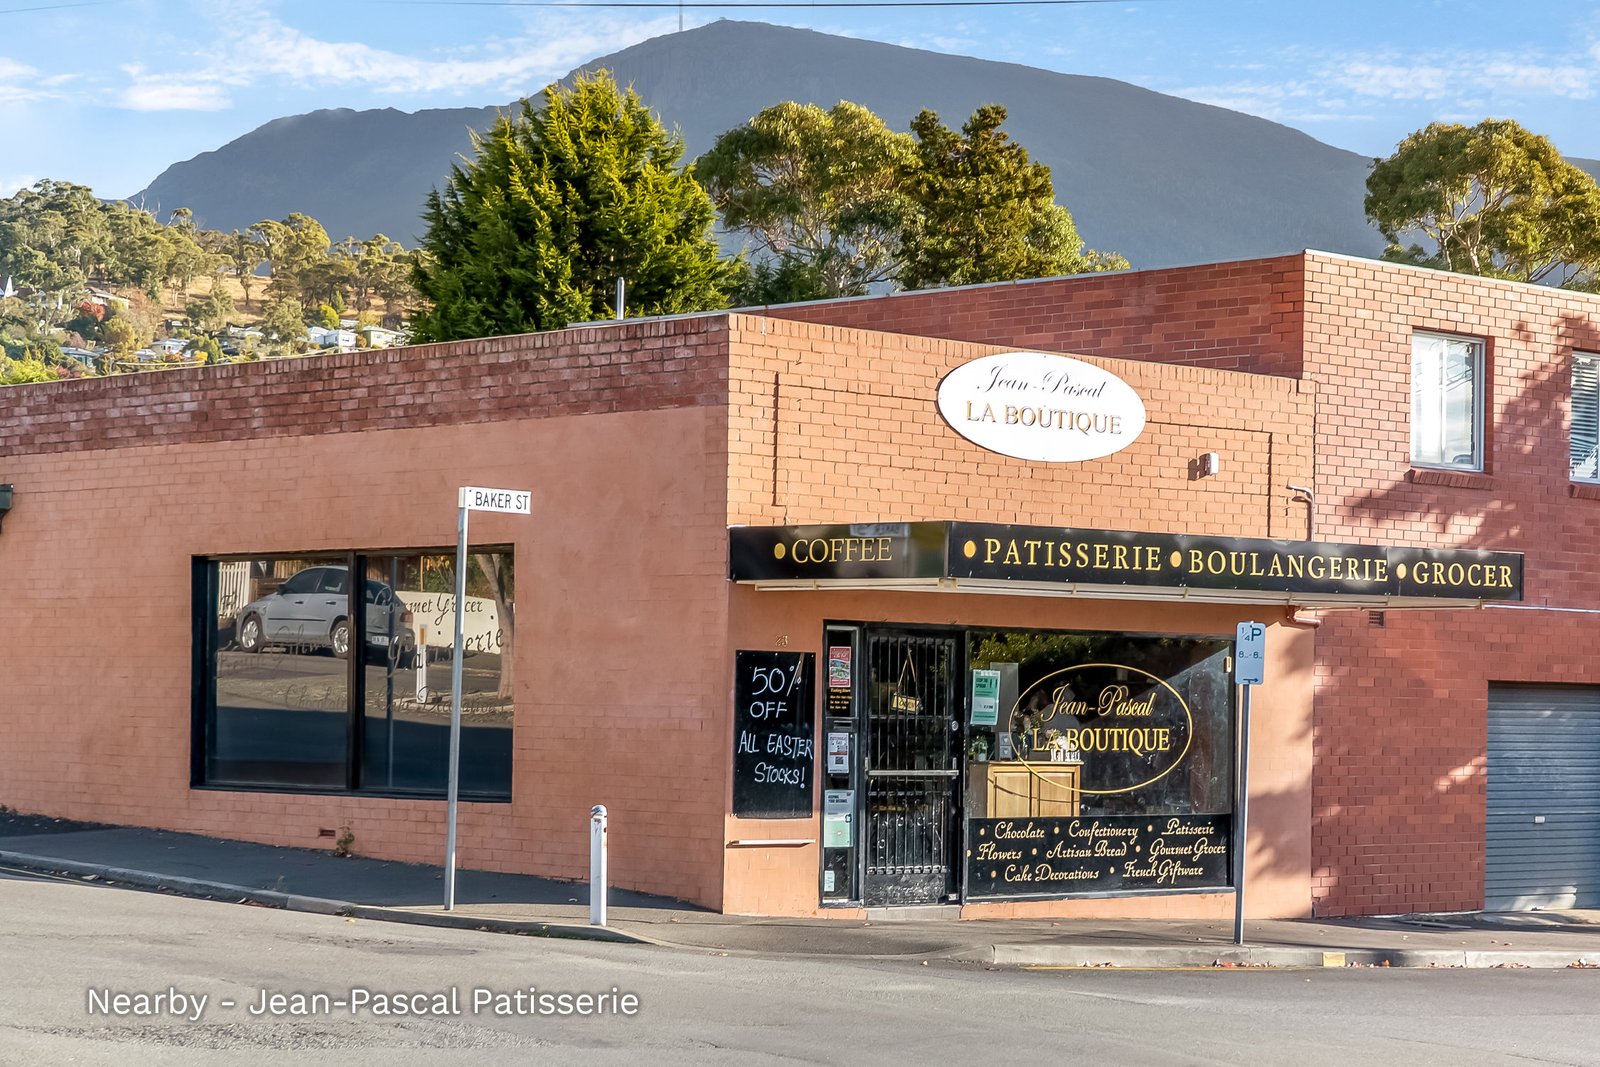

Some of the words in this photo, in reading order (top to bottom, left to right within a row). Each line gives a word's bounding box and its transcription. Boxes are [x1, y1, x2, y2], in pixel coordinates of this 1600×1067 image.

[966, 400, 997, 423] LA
[1004, 404, 1122, 435] BOUTIQUE
[475, 491, 512, 509] BAKER
[515, 495, 528, 510] ST
[791, 537, 893, 564] COFFEE
[984, 538, 1162, 571] PATISSERIE
[1188, 549, 1388, 582] BOULANGERIE
[1412, 561, 1514, 588] GROCER
[434, 592, 483, 626] Grcer
[752, 660, 801, 697] 50%
[749, 701, 788, 720] OFF
[1040, 683, 1157, 721] Jean-Pascal
[738, 730, 760, 754] ALL
[767, 733, 813, 760] EASTER
[1032, 728, 1059, 751] LA
[1066, 728, 1170, 757] BOUTIQUE
[754, 761, 805, 789] STOCKS!
[994, 821, 1045, 839] Chocolate
[1068, 819, 1139, 845] Confectionery
[1161, 818, 1214, 835] Patisserie
[976, 841, 1022, 860] Flowers
[1046, 840, 1092, 859] Artisan
[1094, 840, 1127, 857] Bread
[1148, 838, 1193, 862] Gourmet
[1192, 837, 1226, 862] Grocer
[1004, 864, 1032, 882] Cake
[1035, 863, 1100, 882] Decorations
[1122, 859, 1156, 877] French
[1156, 859, 1204, 884] Giftware
